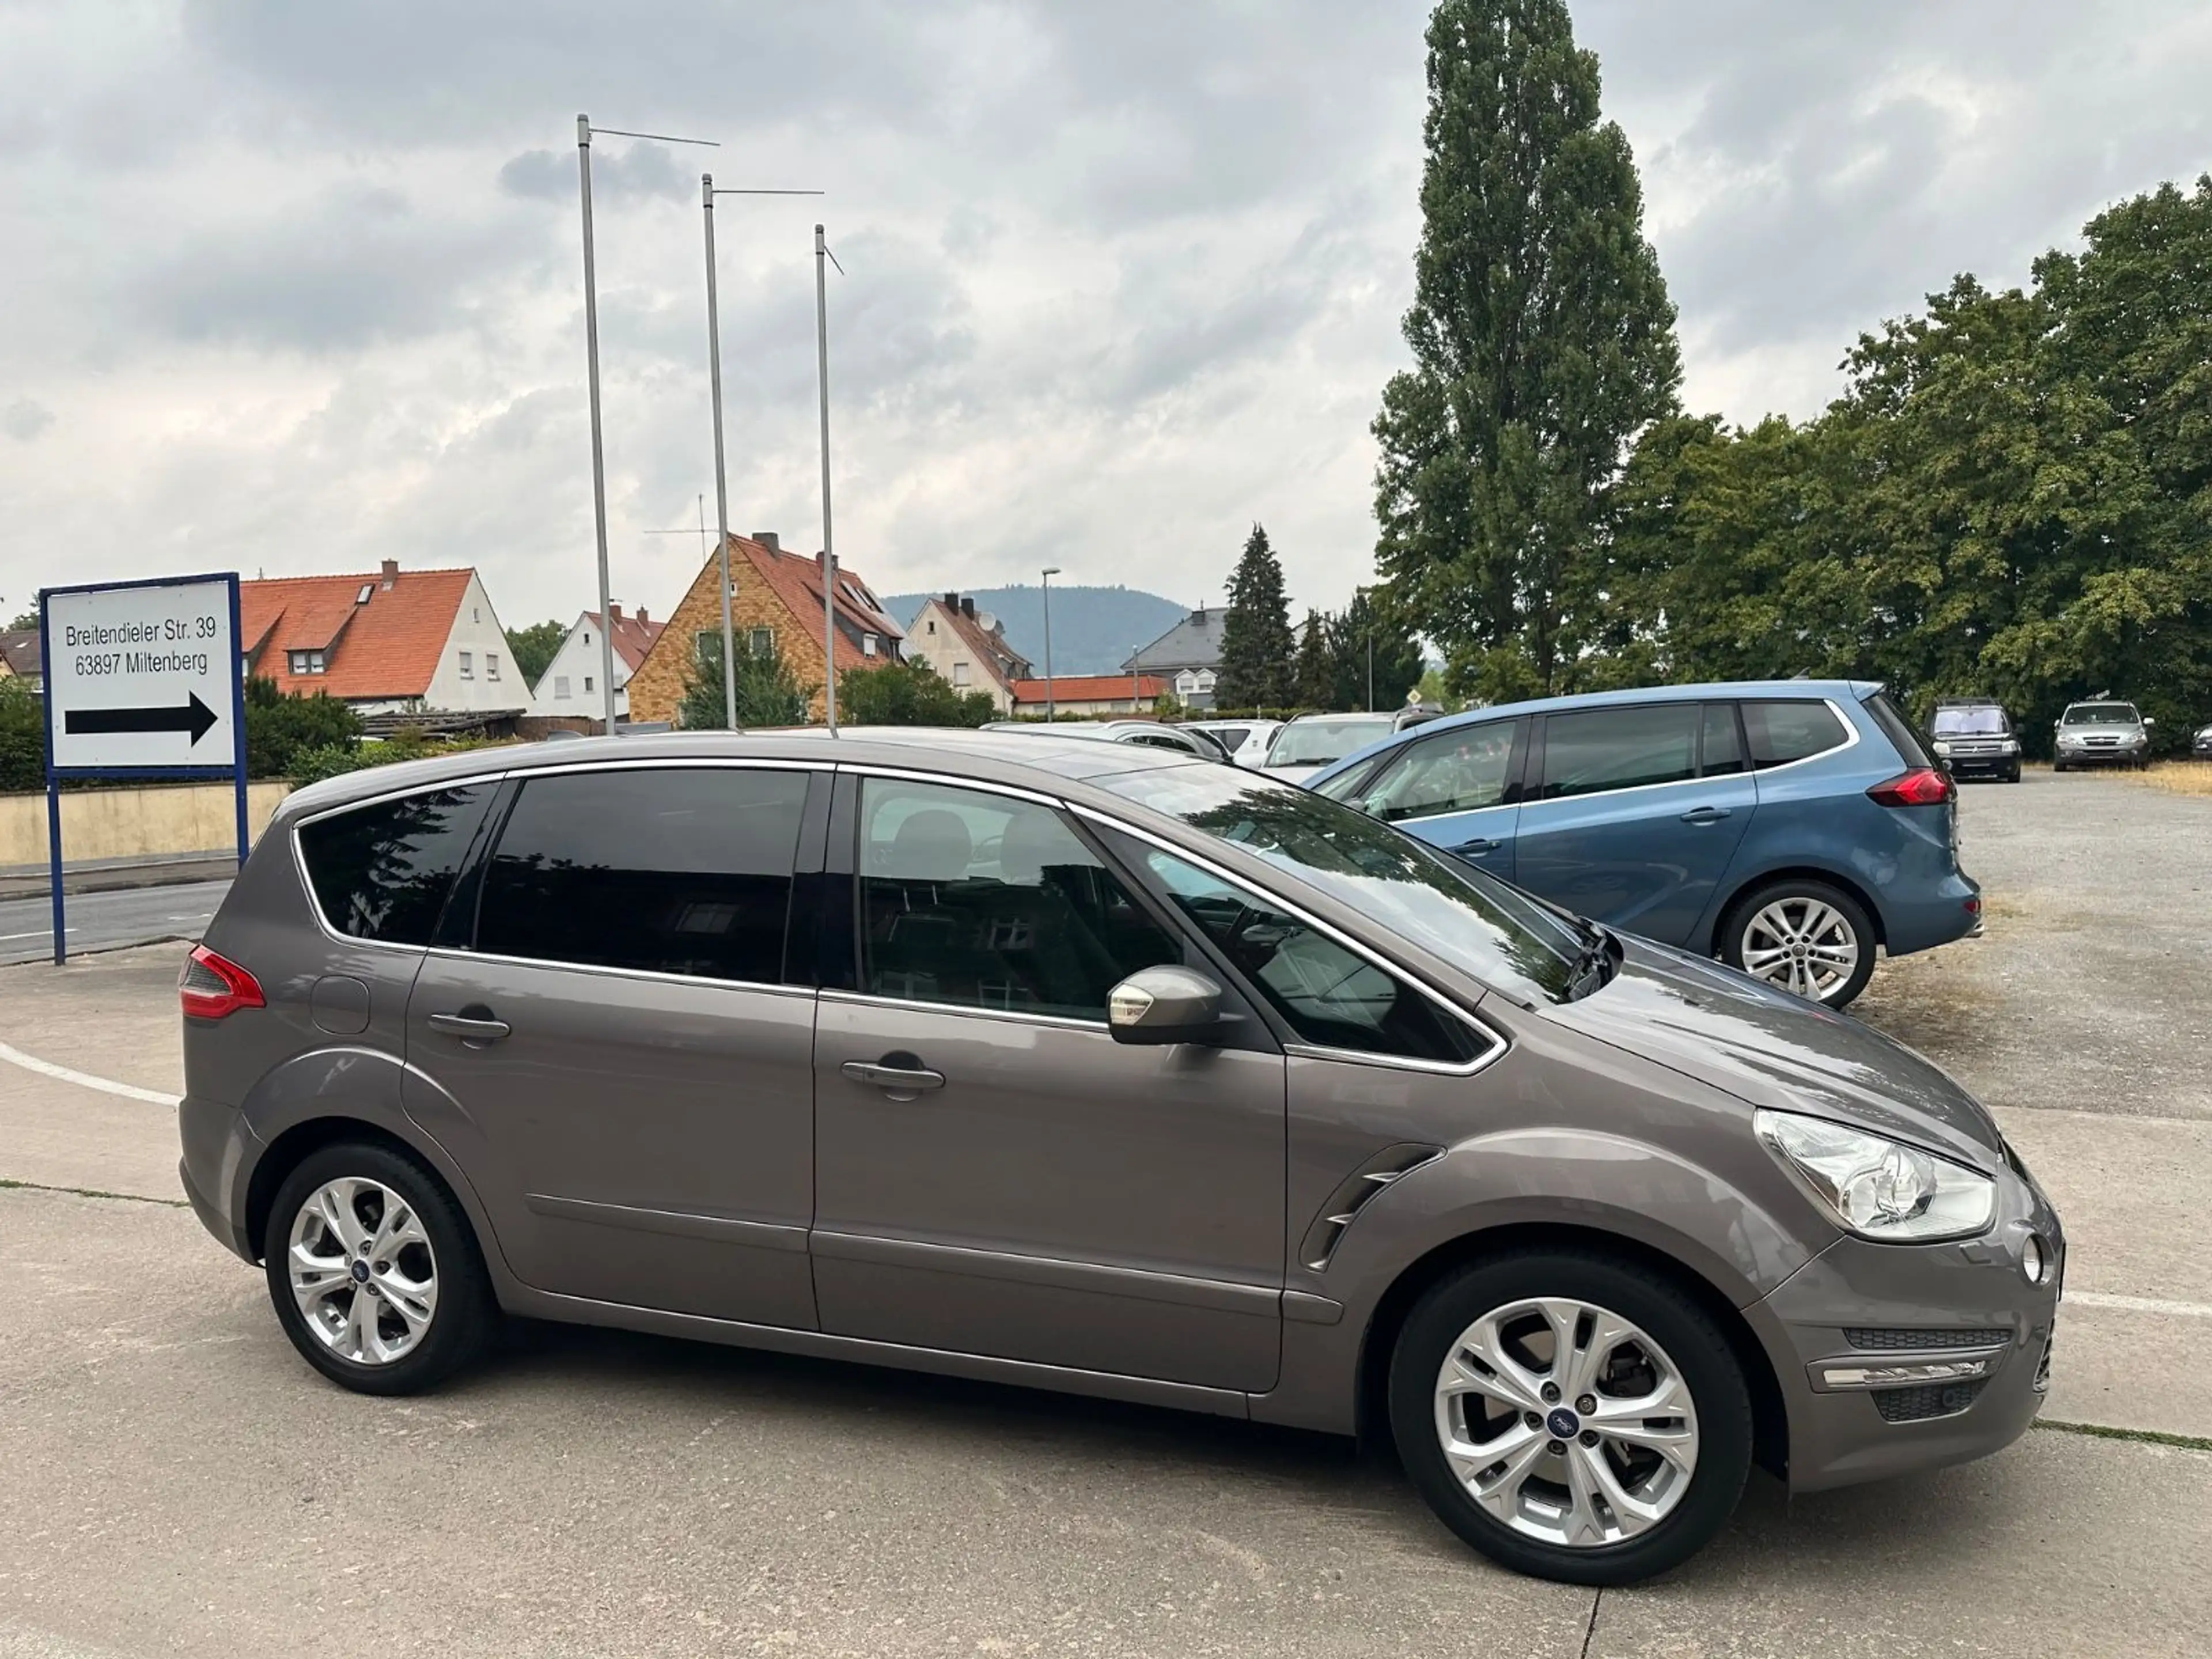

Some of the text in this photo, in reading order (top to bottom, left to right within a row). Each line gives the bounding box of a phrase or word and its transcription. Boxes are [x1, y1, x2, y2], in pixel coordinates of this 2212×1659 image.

[66, 616, 215, 646] Breitendieler Str. 39
[76, 651, 207, 675] 63897 Miltenberg
